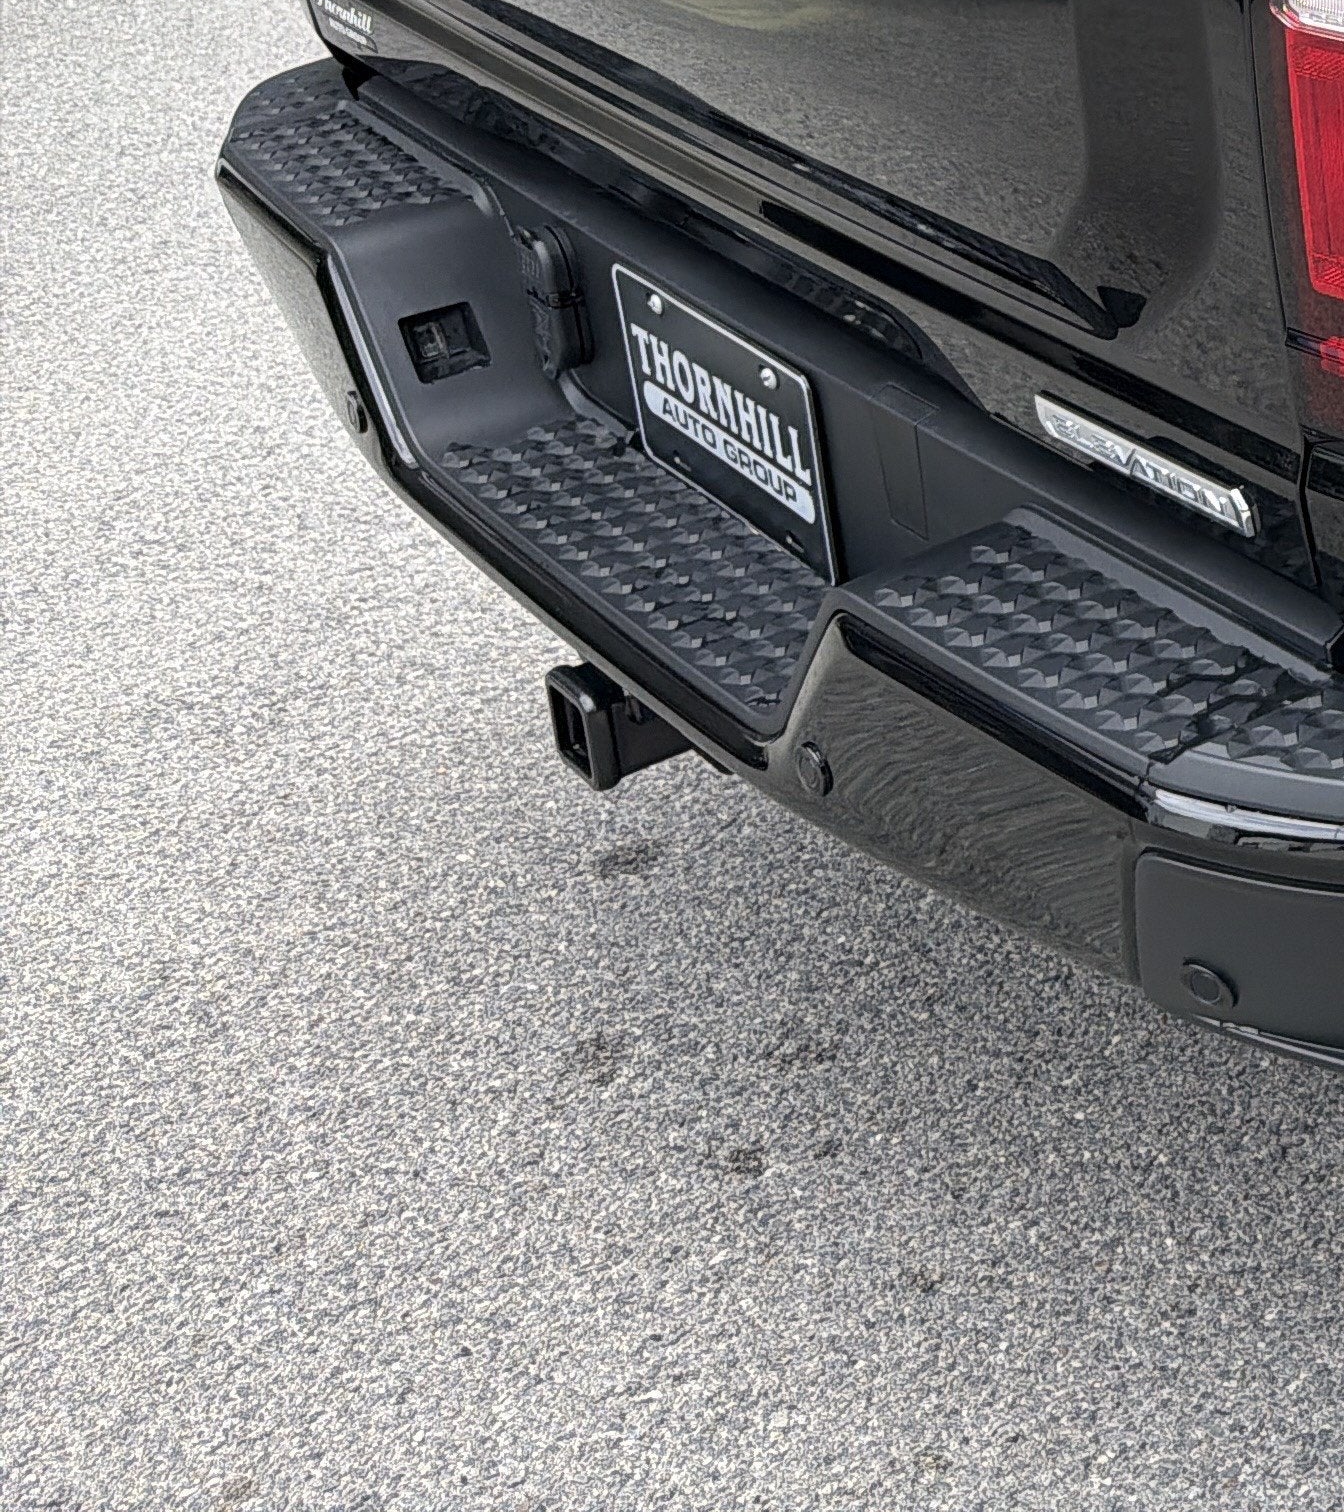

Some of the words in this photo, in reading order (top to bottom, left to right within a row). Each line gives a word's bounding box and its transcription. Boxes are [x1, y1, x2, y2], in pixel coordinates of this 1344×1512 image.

[631, 322, 812, 486] THORNHILL
[662, 397, 717, 449] AUTO
[724, 440, 798, 503] GROUP
[1047, 410, 1245, 531] ELEVATION
